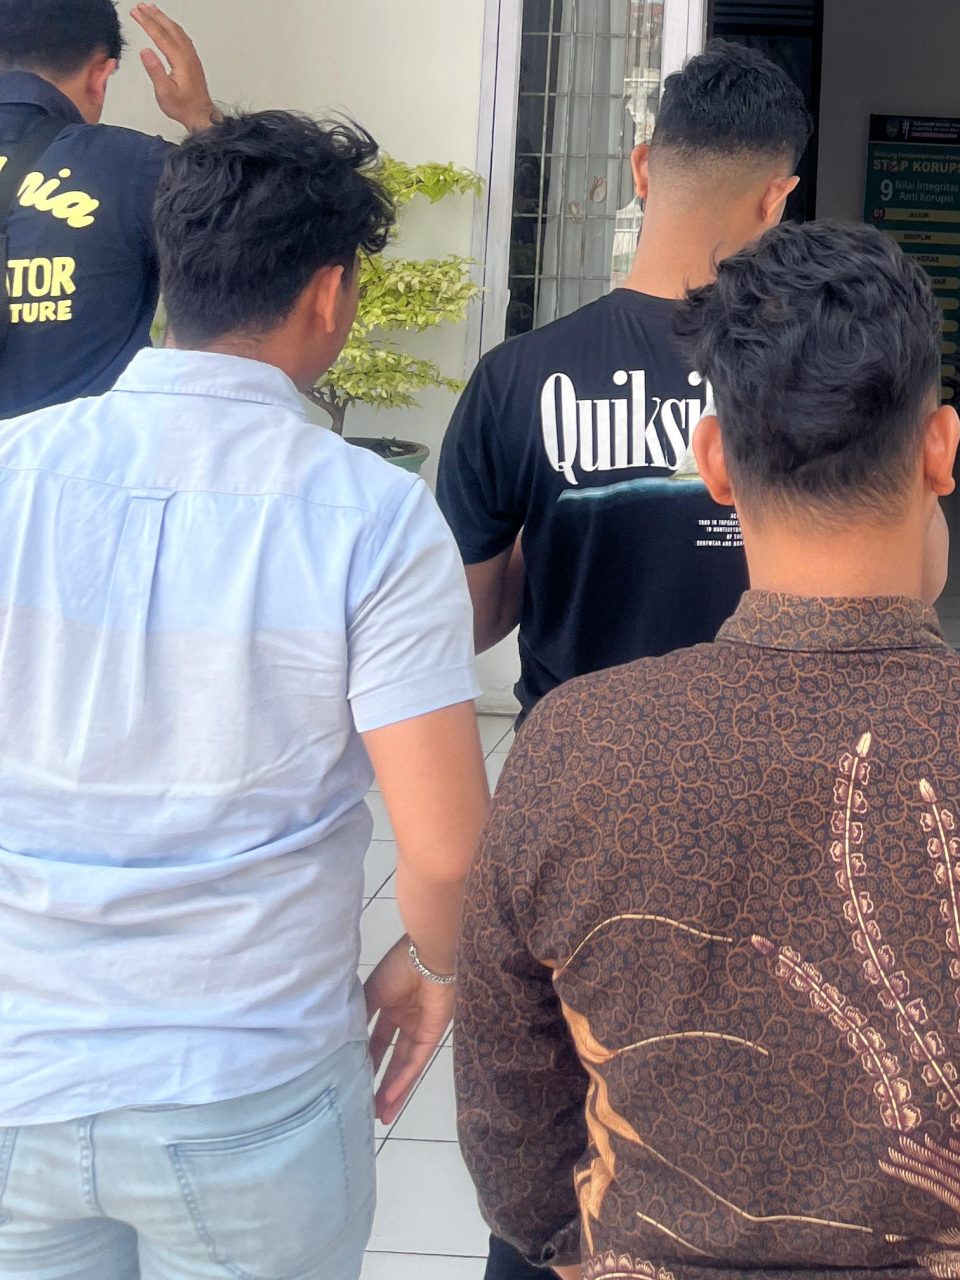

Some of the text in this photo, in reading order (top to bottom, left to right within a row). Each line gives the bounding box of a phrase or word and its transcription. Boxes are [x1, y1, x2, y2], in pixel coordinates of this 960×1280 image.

[880, 179, 893, 201] 9
[896, 180, 959, 193] Nilai Integritas
[900, 193, 954, 204] Anti Korupsi
[6, 256, 76, 297] TOR
[541, 370, 715, 485] Quiksi
